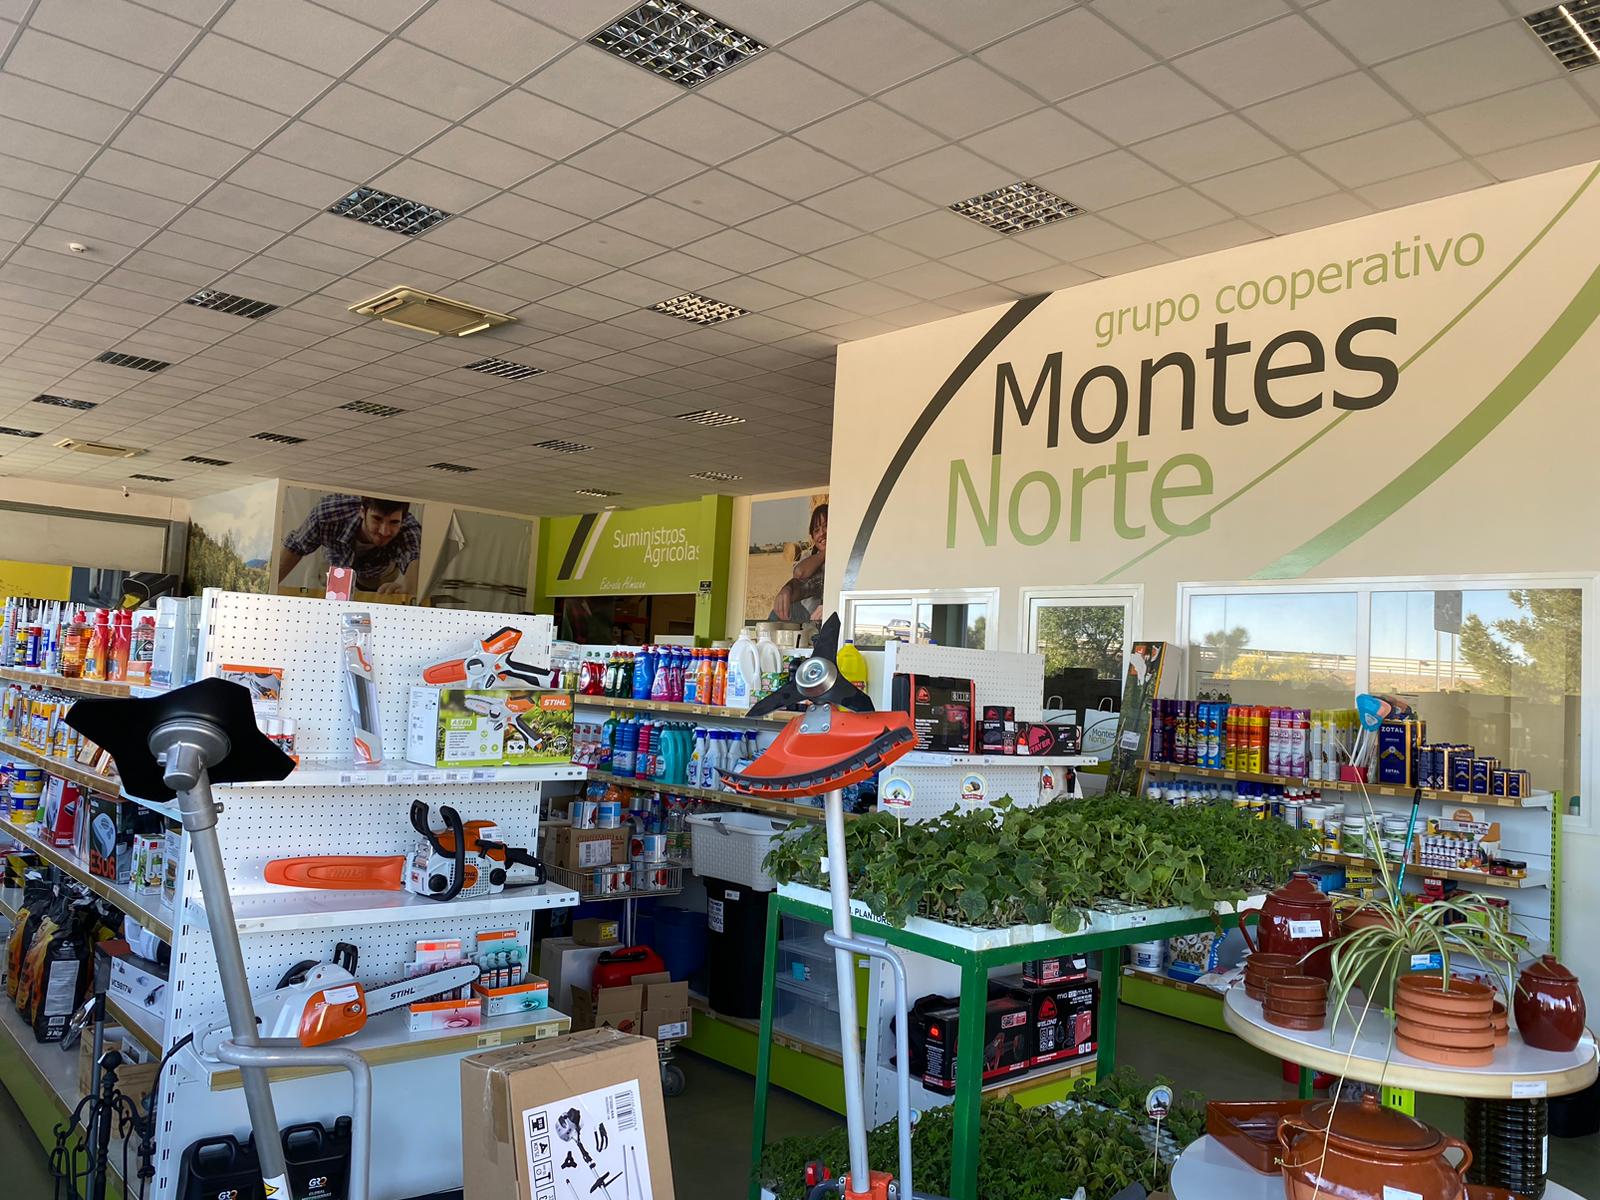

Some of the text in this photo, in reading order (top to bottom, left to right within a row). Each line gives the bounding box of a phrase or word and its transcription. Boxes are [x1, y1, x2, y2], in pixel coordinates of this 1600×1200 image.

[1094, 230, 1486, 348] grupo cooperativo
[991, 316, 1401, 456] Montes
[945, 440, 1215, 550] Norte
[612, 526, 687, 549] Suministros
[543, 698, 568, 706] STIHL
[1092, 728, 1117, 739] Montes
[389, 986, 416, 1000] STIHL
